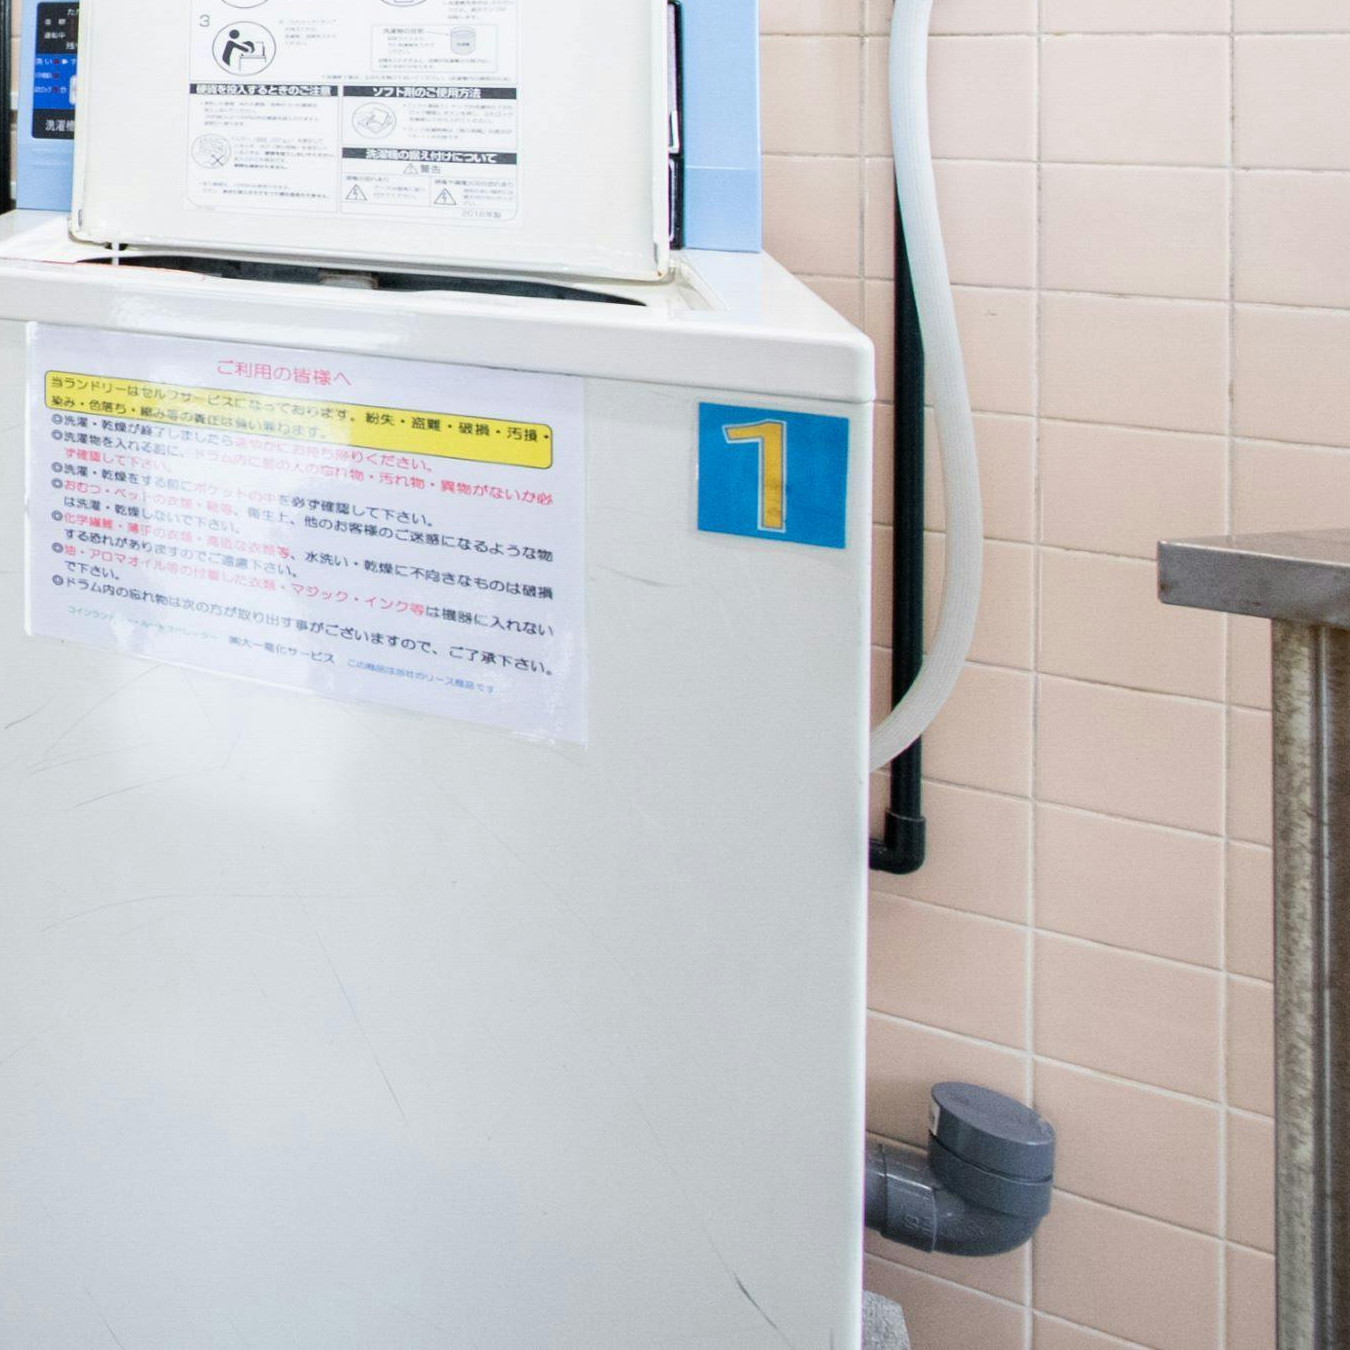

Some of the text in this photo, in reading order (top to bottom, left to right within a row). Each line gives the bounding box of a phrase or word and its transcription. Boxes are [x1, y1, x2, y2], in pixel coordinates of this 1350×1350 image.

[199, 14, 210, 28] 3
[372, 86, 482, 99] ソフト剤のご使用方法
[216, 358, 352, 387] ご利用の皆様へ
[721, 418, 788, 534] 1
